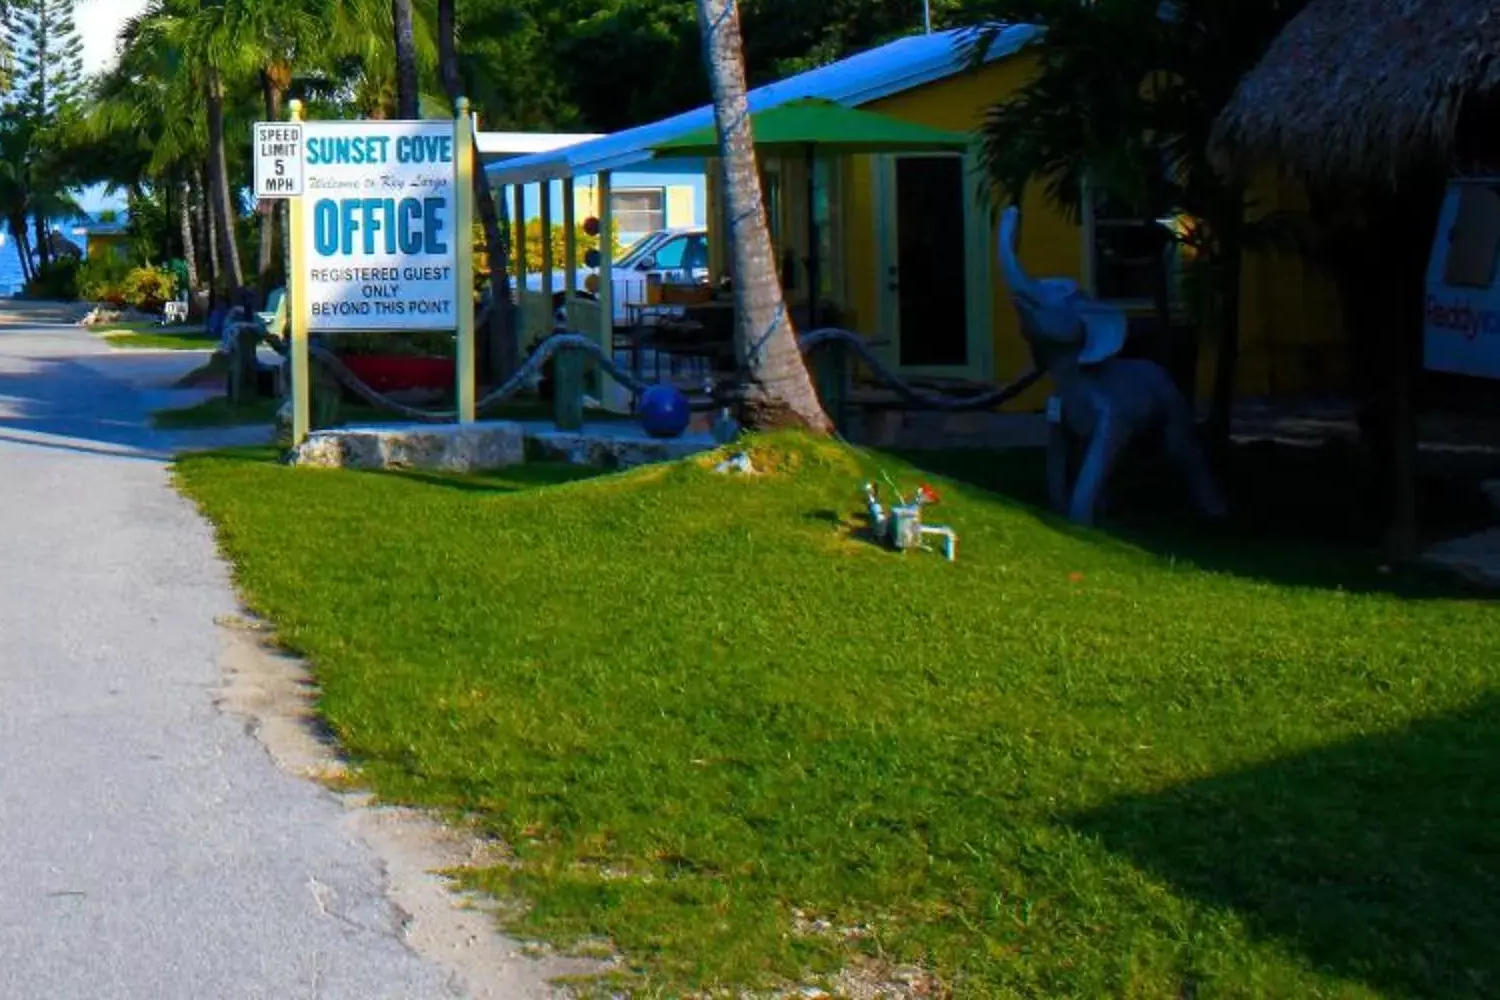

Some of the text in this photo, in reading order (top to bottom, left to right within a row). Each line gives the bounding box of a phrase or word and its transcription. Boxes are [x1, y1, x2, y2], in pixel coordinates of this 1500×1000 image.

[260, 129, 299, 142] SPEED
[262, 144, 297, 157] LIMIT
[306, 135, 453, 165] SUNSET COVE
[274, 160, 285, 175] 5
[266, 178, 294, 191] MPH
[314, 197, 448, 257] OFFICE
[311, 267, 450, 281] REGISTERED GUEST
[362, 284, 400, 298] ONLY
[312, 300, 449, 316] BEYOND THIS POINT
